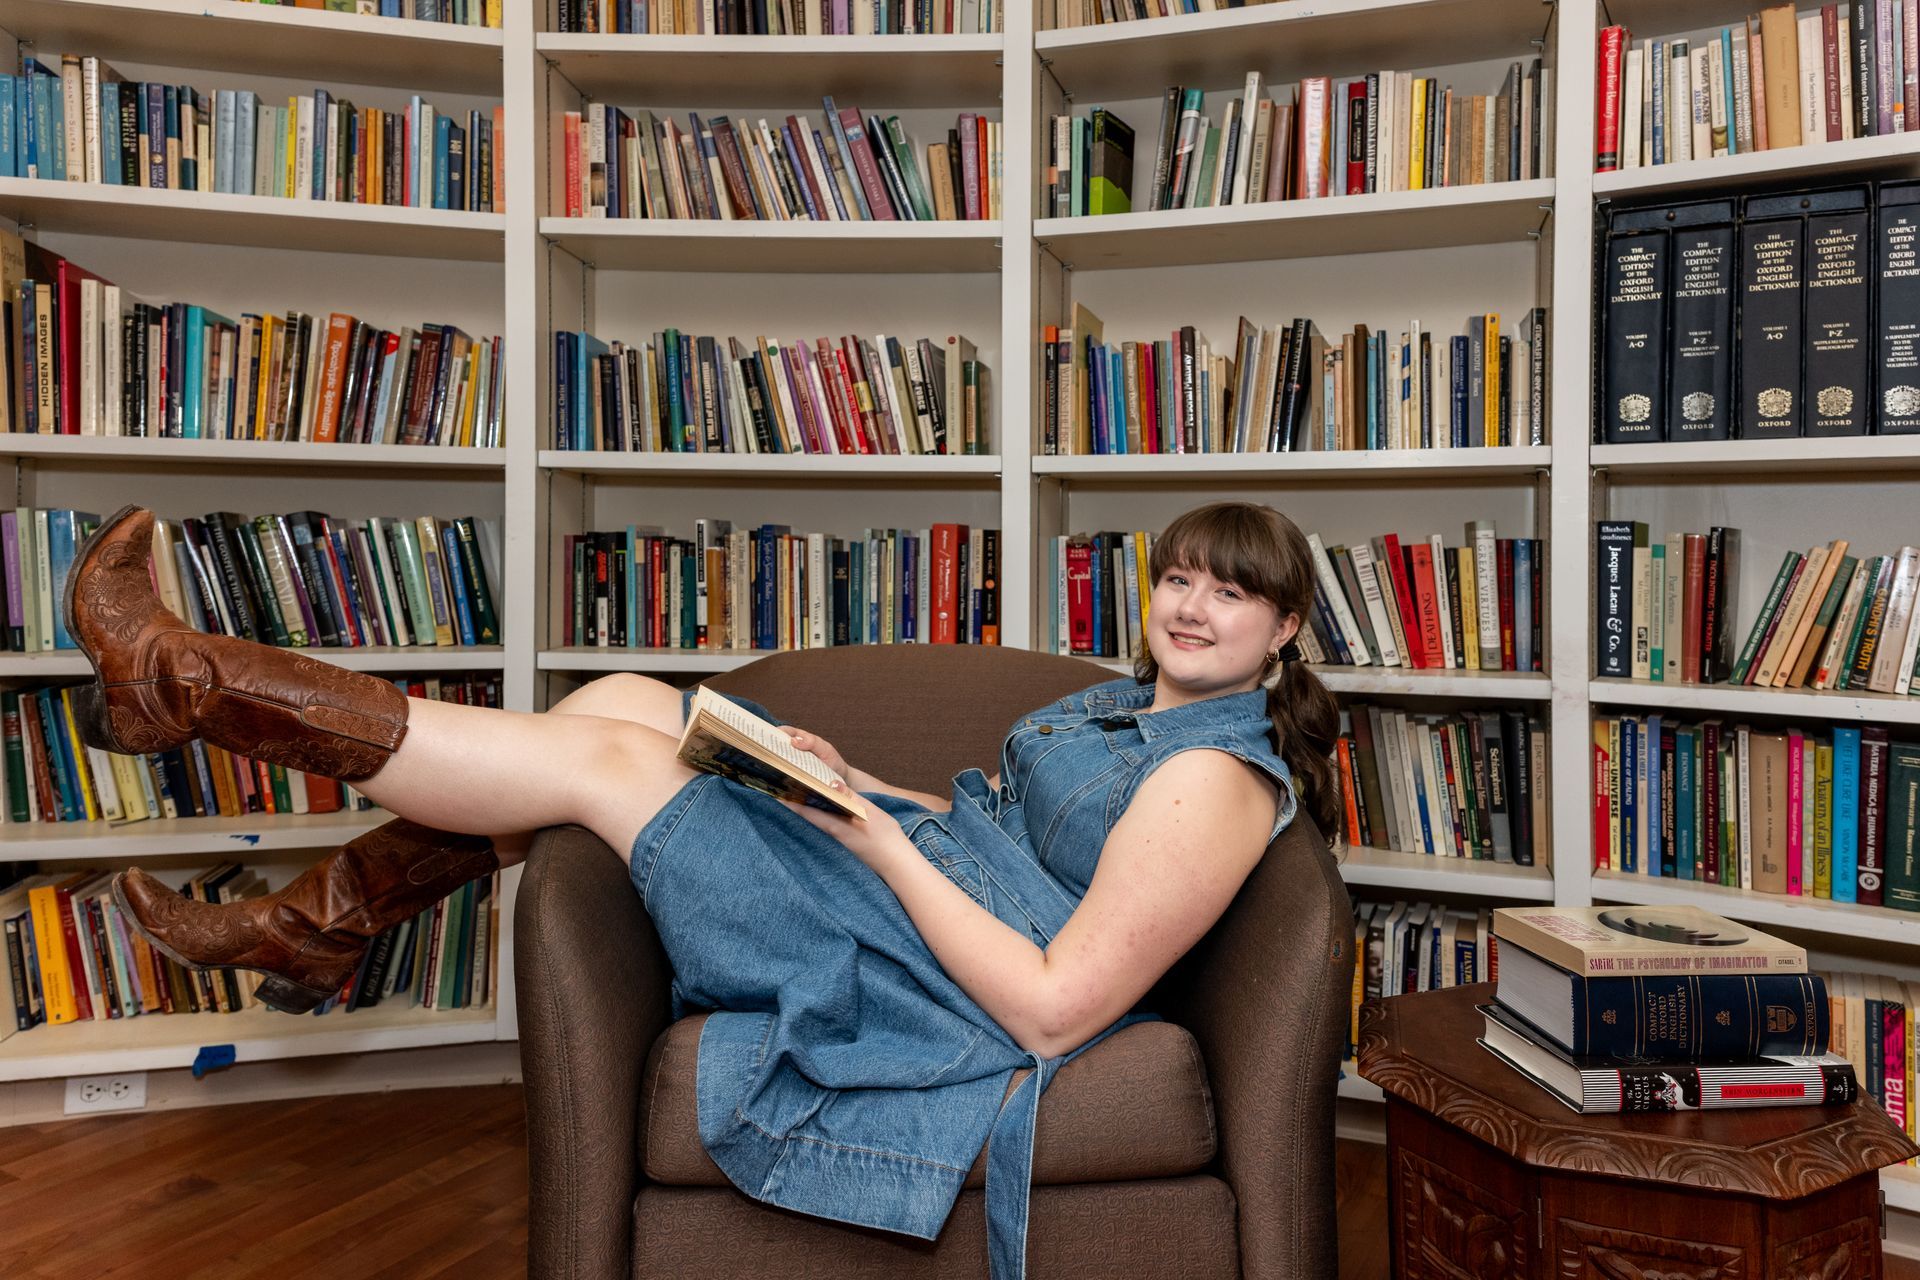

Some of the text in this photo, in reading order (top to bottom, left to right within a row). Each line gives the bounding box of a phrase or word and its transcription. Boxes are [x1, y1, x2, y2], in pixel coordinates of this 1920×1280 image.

[1908, 6, 1917, 69] CONVERSATION
[1740, 50, 1751, 140] EXISTENTIAL FOUNDATIONS
[1861, 96, 1869, 126] Darkness
[1887, 224, 1917, 234] COMPACT
[1753, 239, 1796, 251] COMPACT
[1814, 234, 1858, 246] COMPACT
[1889, 234, 1915, 244] EDITION
[1683, 247, 1723, 258] COMPACT
[1756, 249, 1792, 260] EDITION
[1817, 244, 1855, 255] EDITION
[1889, 250, 1916, 259] OXFORD
[1617, 253, 1657, 263] COMPACT
[1685, 257, 1720, 267] EDITION
[1817, 259, 1856, 270] OXFORD
[1889, 259, 1915, 268] ENGLISH
[1620, 262, 1654, 272] EDITION
[1701, 264, 1713, 272] THE
[1756, 264, 1793, 275] OXFORD
[1818, 268, 1855, 278] ENGLISH
[1883, 267, 1920, 278] DICTIONARY
[1619, 277, 1654, 286] OXFORD
[1684, 271, 1720, 281] OXFORD
[1757, 273, 1792, 283] ENGLISH
[1809, 276, 1864, 288] DICTIONARY
[1620, 285, 1654, 294] ENGLISH
[1685, 279, 1719, 289] ENGLISH
[1749, 281, 1800, 292] DICTIONARY
[1611, 292, 1663, 304] DICTIONARY
[1675, 287, 1728, 298] DICTIONARY
[1766, 333, 1784, 341] A-O
[1828, 329, 1843, 337] P-Z
[1628, 340, 1645, 349] A-O
[40, 314, 49, 406] HIDDEN IMAGES
[318, 340, 343, 438] Apocalyptic Spirituality
[1184, 354, 1195, 427] Personal Maturity
[915, 386, 926, 410] FORCE
[1619, 424, 1651, 432] OXFORD
[214, 527, 225, 543] THE
[218, 544, 232, 573] GOSPEL
[309, 550, 320, 570] MARY
[229, 582, 240, 597] THE
[1478, 544, 1491, 632] GREAT VIRTUES
[1606, 545, 1622, 653] Jacques Lacan & Co.
[233, 599, 250, 630] ZODIAC
[1866, 588, 1888, 635] GANDHI'S
[1422, 592, 1438, 650] DEATHING
[1857, 637, 1876, 671] TRUTH
[1434, 742, 1444, 776] COMPOSING
[1534, 744, 1544, 759] Love
[1536, 760, 1544, 773] and
[1870, 744, 1879, 776] MATERIA
[1489, 747, 1503, 805] Schizophrenia
[1681, 751, 1689, 792] RESONANCE
[1815, 774, 1831, 819] Anatomy
[1868, 777, 1878, 807] MEDICA
[1818, 821, 1830, 830] of
[1867, 816, 1877, 845] HUMAN
[1817, 831, 1827, 844] an
[1816, 846, 1831, 877] Illness
[1866, 846, 1876, 868] MIND
[474, 939, 484, 974] SAINTS
[1589, 958, 1614, 970] SARTRE
[1616, 958, 1635, 970] THE
[1637, 957, 1691, 970] PSYCHOLOGY
[1694, 957, 1705, 970] OF
[1708, 956, 1768, 969] IMAGINATION
[1648, 991, 1657, 1041] COMPACT
[1658, 995, 1667, 1039] OXFORD
[1668, 994, 1676, 1040] ENGLISH
[1677, 984, 1687, 1048] DICTIONARY
[1806, 1001, 1815, 1037] OXFORD
[1633, 1076, 1642, 1110] NIGHT
[1642, 1076, 1650, 1110] CIRCUS
